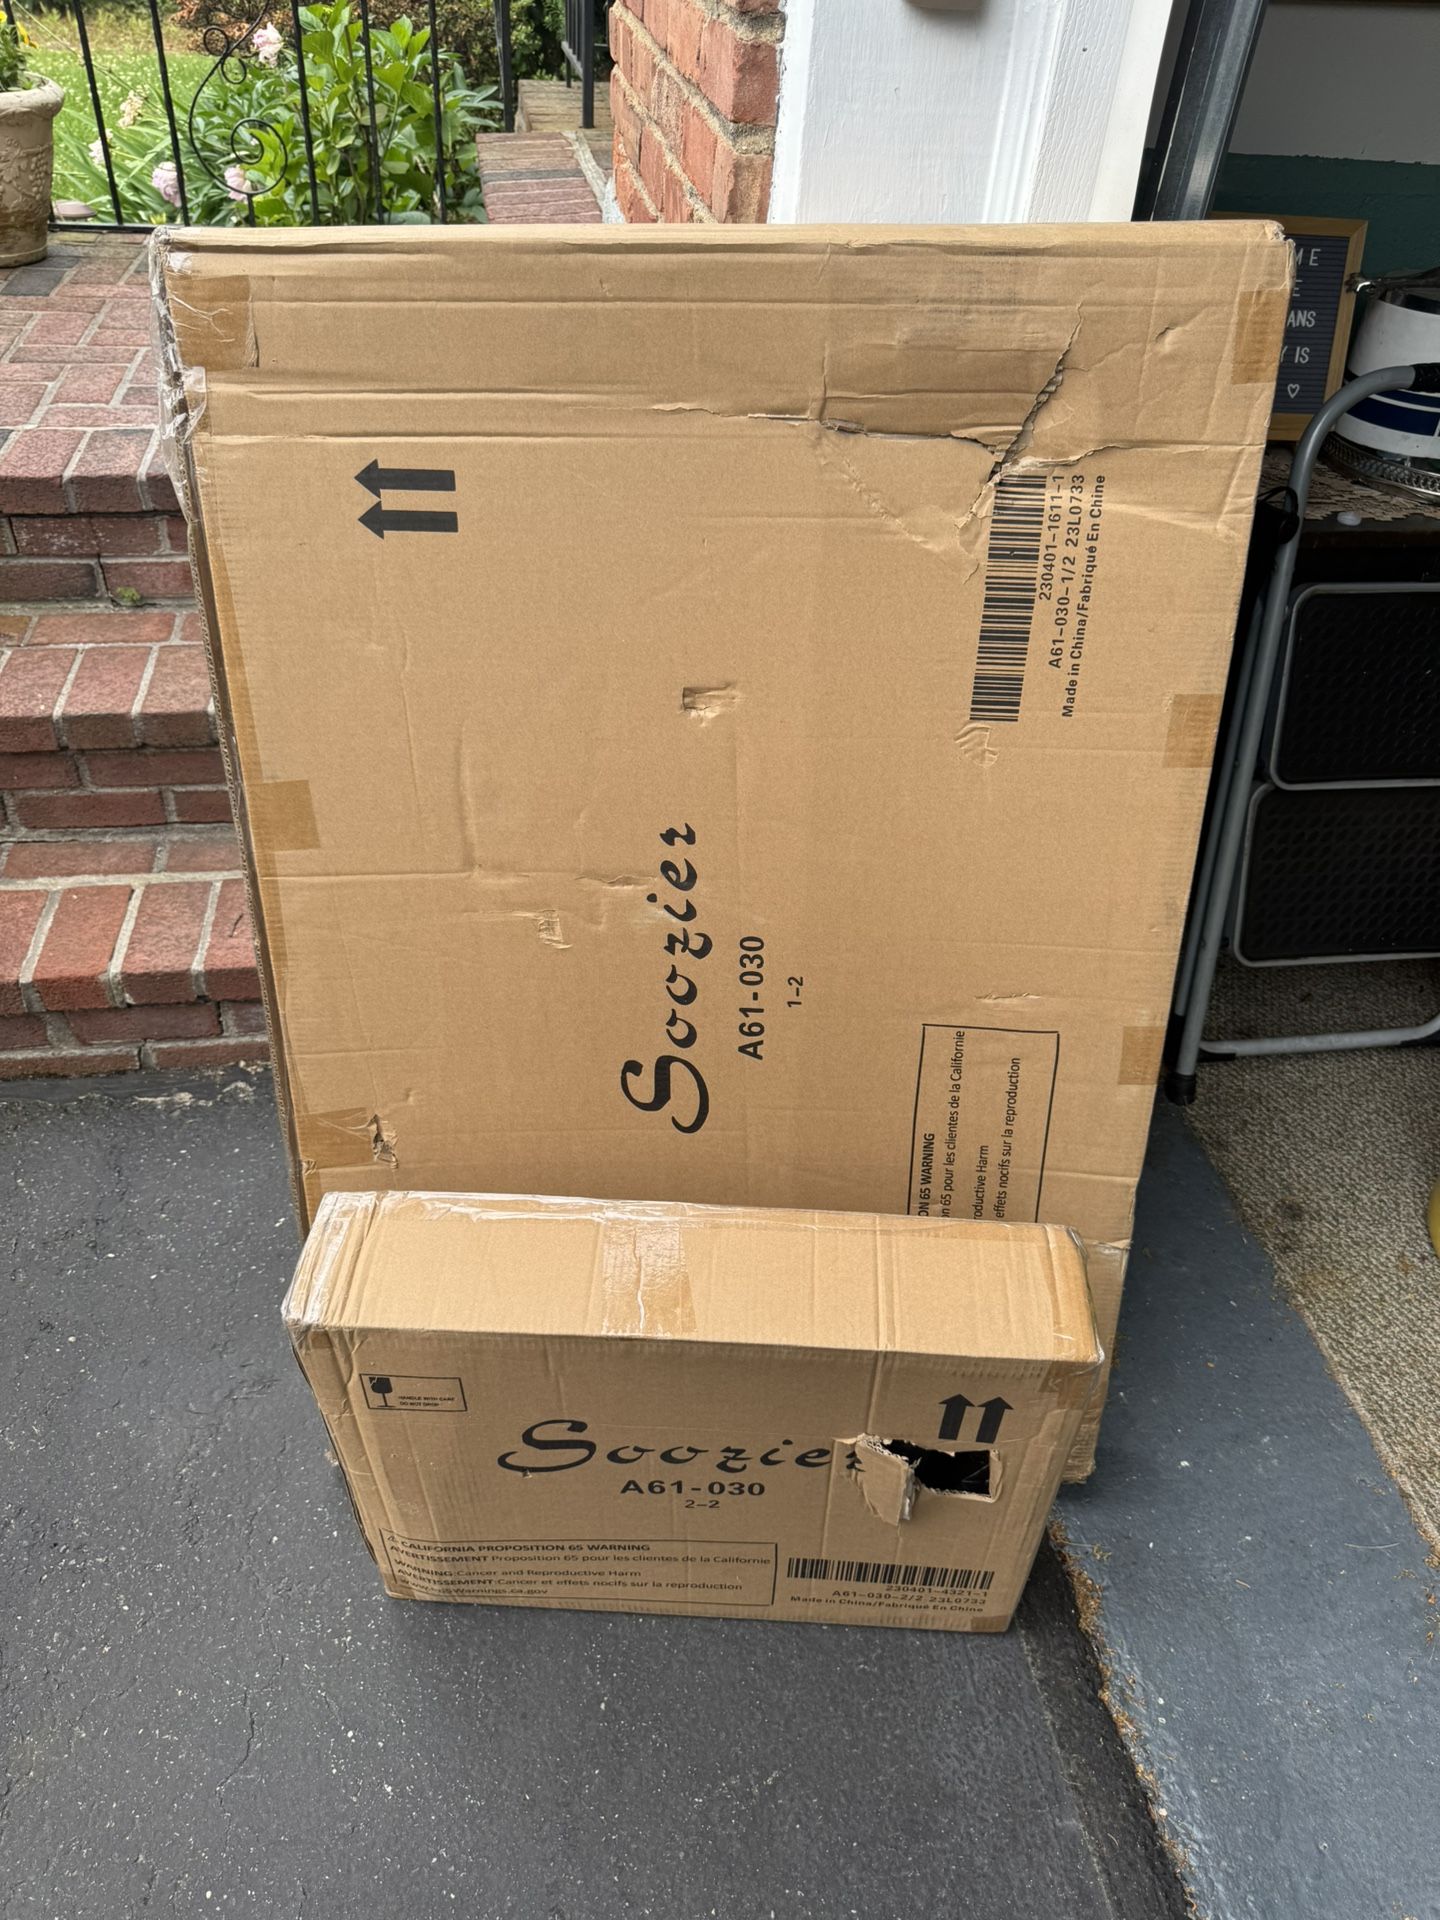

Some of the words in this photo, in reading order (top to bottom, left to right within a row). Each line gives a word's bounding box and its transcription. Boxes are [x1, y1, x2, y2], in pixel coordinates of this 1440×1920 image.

[1294, 346, 1310, 364] IS
[1090, 475, 1106, 516] Chine
[1039, 475, 1065, 601] 230401-1611-1
[1086, 523, 1101, 542] En
[1049, 555, 1077, 669] A61-030-1/2
[1066, 474, 1085, 548] 23L0733
[1070, 545, 1098, 663] China/Fabriqué
[1067, 663, 1080, 678] in
[1062, 679, 1079, 717] Made
[620, 822, 713, 1134] Soozier
[738, 936, 765, 1061] A61-030
[787, 976, 804, 1009] 1-2
[950, 1030, 965, 1081] Californie
[949, 1083, 961, 1093] la
[1005, 1057, 1021, 1126] reproduction
[948, 1095, 960, 1109] de
[945, 1110, 959, 1150] clientes
[1001, 1129, 1014, 1138] la
[943, 1151, 956, 1166] les
[1002, 1140, 1012, 1157] sur
[920, 1133, 935, 1185] WARNING
[976, 1145, 989, 1173] Harm
[944, 1168, 954, 1191] pour
[998, 1159, 1010, 1188] nocifs
[920, 1187, 931, 1200] 65
[940, 1193, 952, 1206] 65
[993, 1190, 1007, 1218] effets
[620, 1480, 766, 1497] A61-030
[684, 1499, 721, 1509] 2-2
[390, 1545, 489, 1563] AVERTISSEMENT
[492, 1555, 561, 1563] Proposition
[614, 1554, 630, 1562] les
[632, 1554, 679, 1563] clientes
[681, 1555, 698, 1563] de
[700, 1555, 711, 1564] la
[713, 1556, 772, 1566] Californie
[401, 1541, 475, 1553] CALIFORNIA
[478, 1544, 565, 1552] PROPOSITION
[587, 1544, 651, 1552] WARNING
[527, 1569, 605, 1578] Reproductive
[593, 1580, 628, 1588] nocifs
[652, 1580, 662, 1588] la
[665, 1582, 743, 1591] reproduction
[832, 1590, 923, 1602] A61-030-2/2
[929, 1596, 986, 1605] 23L0733
[950, 1605, 984, 1613] Chine
